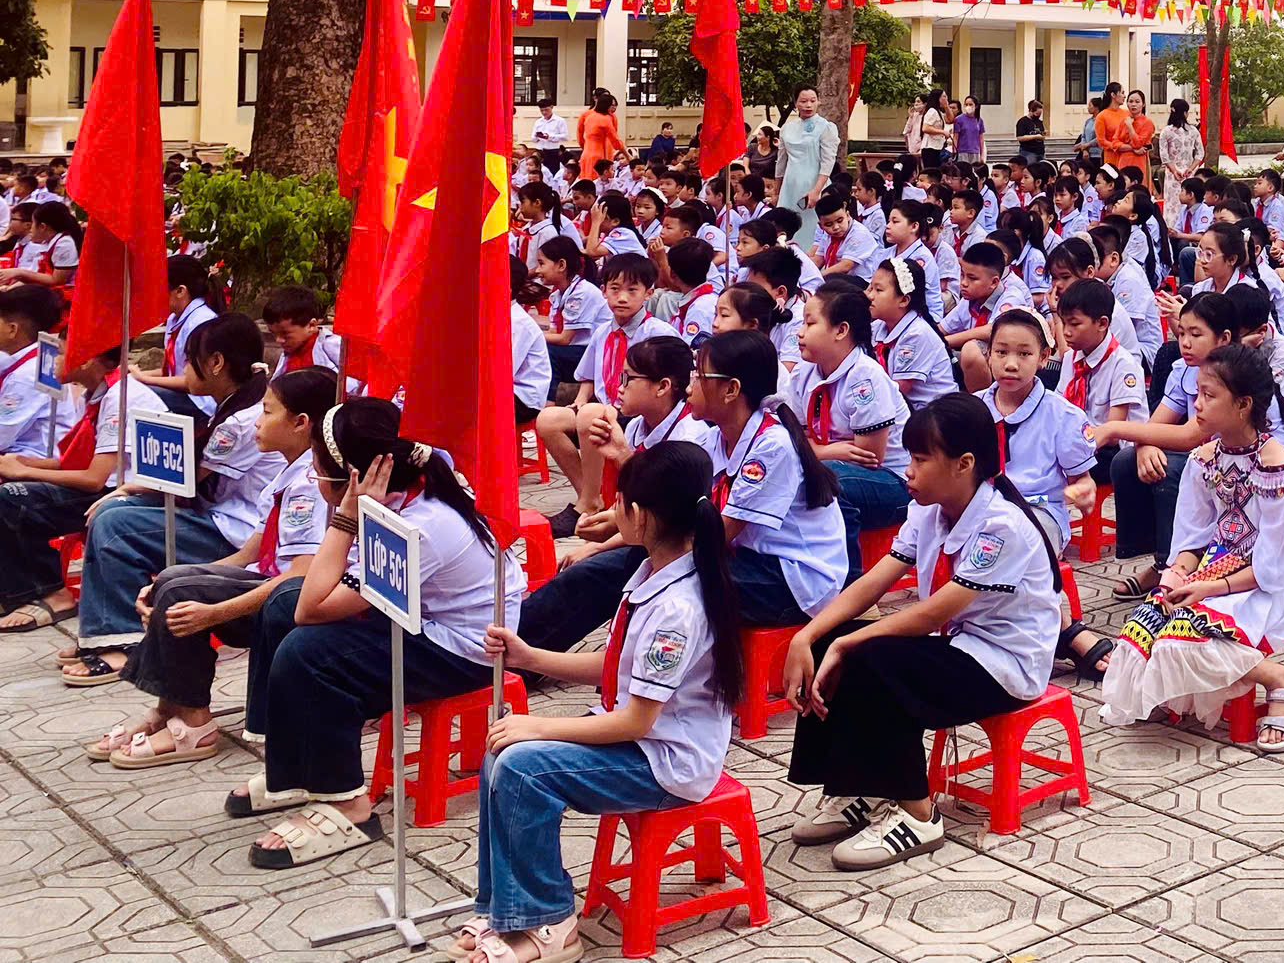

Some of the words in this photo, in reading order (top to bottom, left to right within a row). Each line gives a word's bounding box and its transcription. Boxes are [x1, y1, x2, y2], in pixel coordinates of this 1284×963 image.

[140, 431, 160, 466] LỚP
[162, 441, 183, 473] 5C2
[368, 533, 387, 579] LỚP
[389, 549, 407, 596] 5C1
